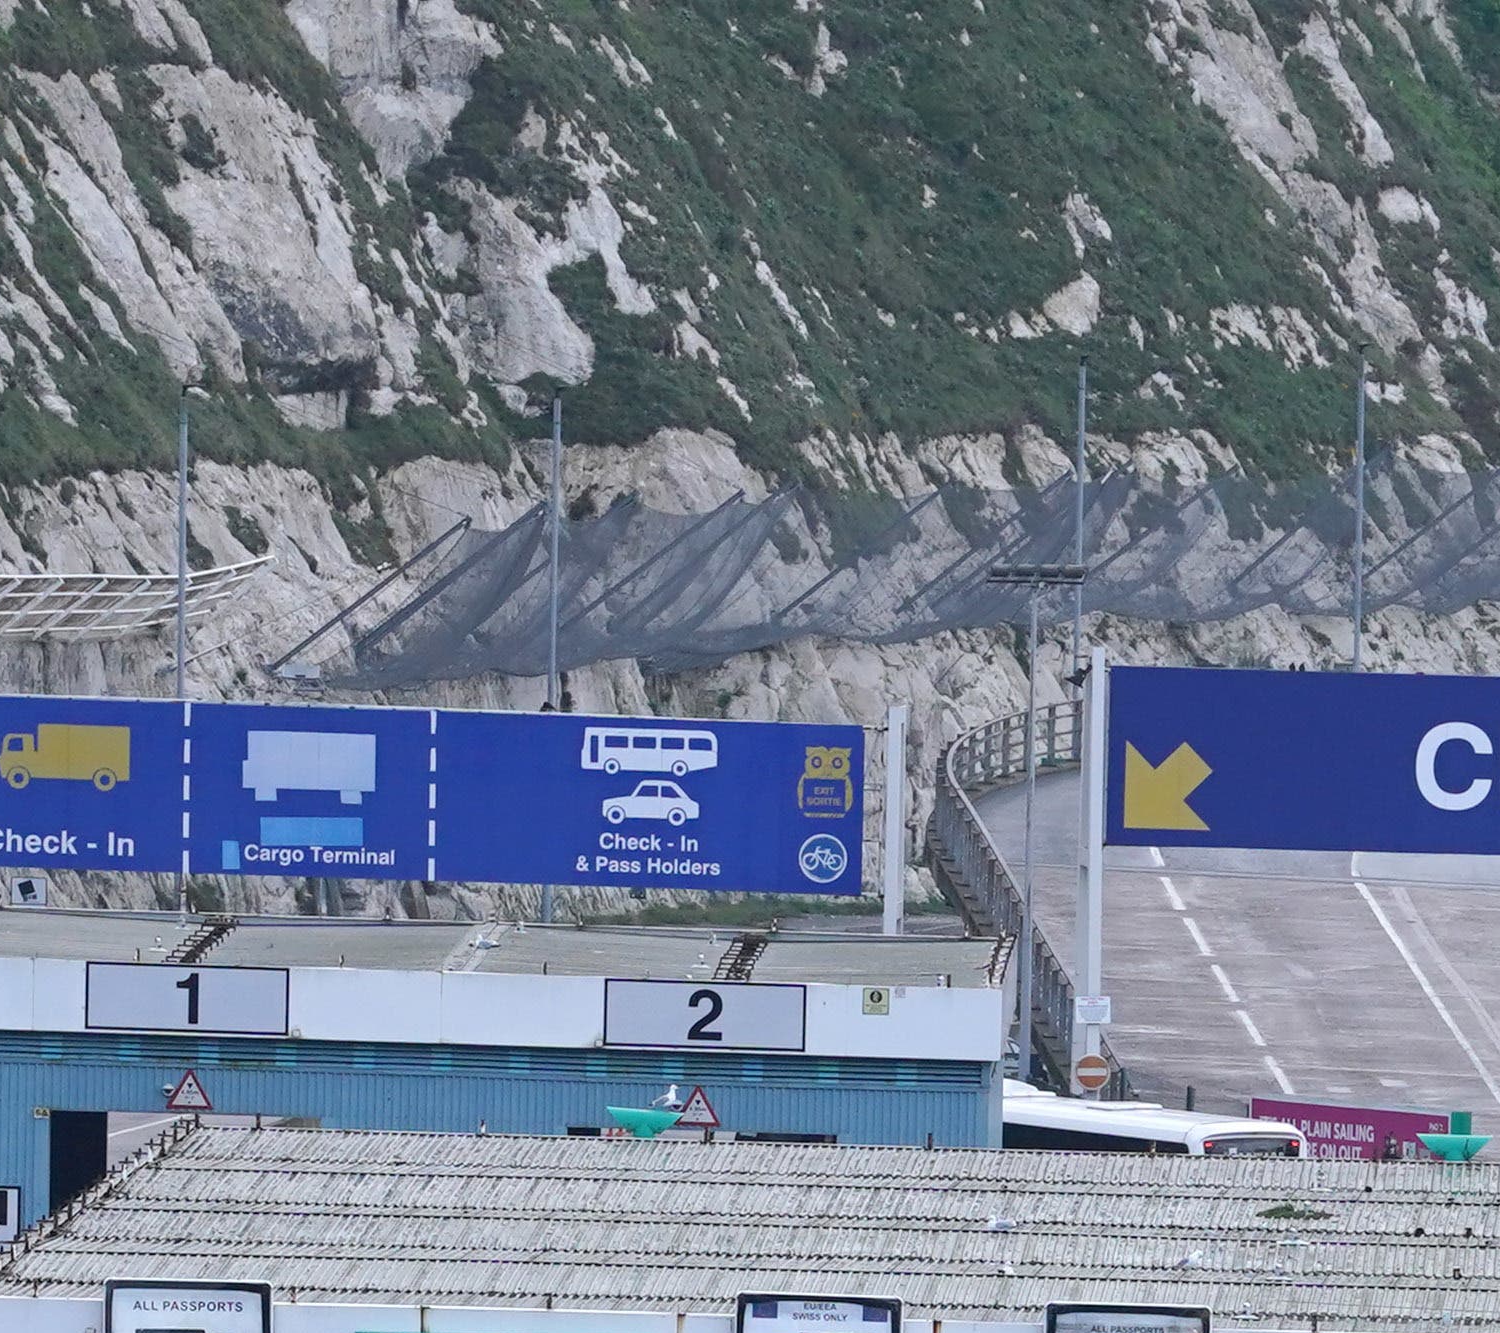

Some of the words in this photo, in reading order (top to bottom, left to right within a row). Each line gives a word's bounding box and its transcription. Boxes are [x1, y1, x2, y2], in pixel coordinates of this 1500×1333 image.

[813, 787, 835, 796] EXIT
[107, 830, 134, 857] In
[598, 831, 655, 852] Check
[679, 833, 698, 852] In
[243, 844, 302, 868] Cargo
[306, 845, 395, 866] Terminal
[575, 857, 590, 871] &
[594, 857, 640, 872] Pass
[644, 858, 721, 876] Holders
[176, 972, 200, 1024] 1
[687, 989, 724, 1042] 2
[1299, 1120, 1330, 1139] PLAIN
[1332, 1122, 1374, 1143] SAILING
[133, 1300, 159, 1312] ALL
[162, 1300, 244, 1313] PASSPORTS
[802, 1302, 836, 1311] EU/EEA
[791, 1312, 819, 1322] SWISS
[821, 1313, 848, 1323] ONLY
